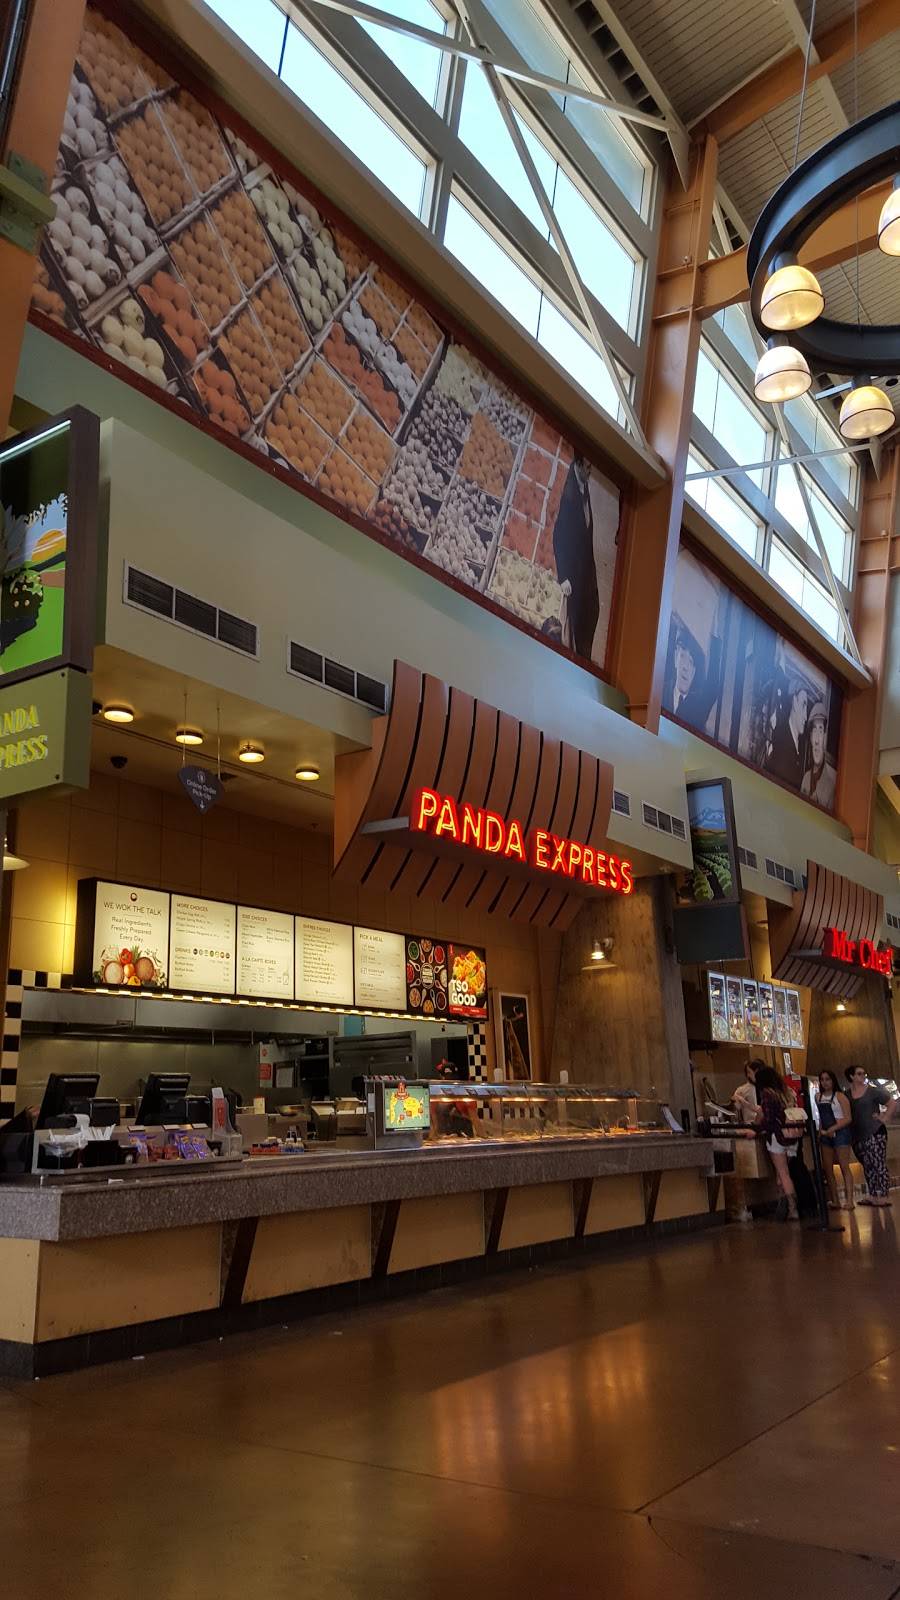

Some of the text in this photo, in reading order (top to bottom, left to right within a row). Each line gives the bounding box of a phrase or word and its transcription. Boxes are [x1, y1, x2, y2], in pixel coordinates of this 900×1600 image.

[411, 786, 636, 895] PANDA EXPRESS
[103, 901, 162, 917] WE WOK THE TALK
[133, 935, 144, 944] Day
[830, 927, 857, 963] Mr
[451, 979, 469, 993] TSO
[451, 992, 477, 1006] GOOD
